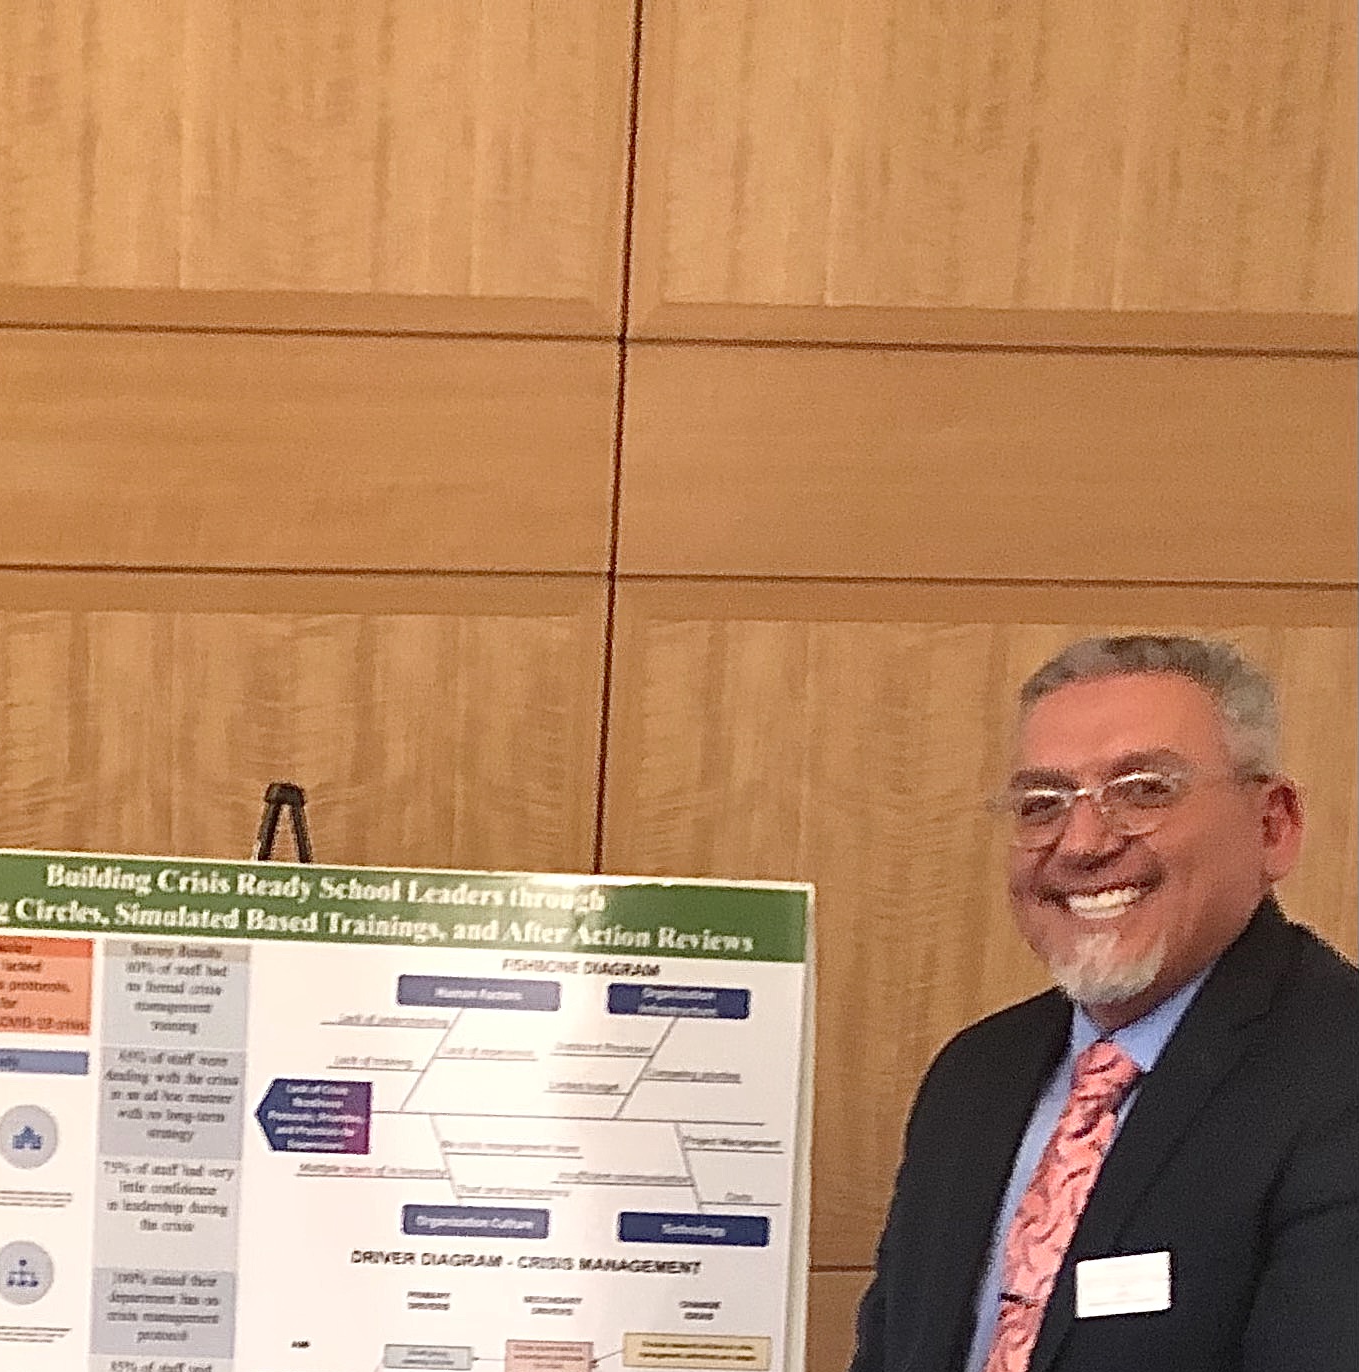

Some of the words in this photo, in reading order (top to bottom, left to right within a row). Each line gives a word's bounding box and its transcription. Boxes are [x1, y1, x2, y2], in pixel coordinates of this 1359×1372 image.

[47, 863, 152, 897] Building
[157, 869, 230, 895] Crisis
[237, 873, 311, 903] Ready
[319, 877, 401, 902] School
[408, 880, 504, 907] Leaders
[510, 886, 606, 913] through
[15, 898, 109, 926] Circles,
[115, 901, 240, 930] Simulated
[246, 908, 318, 933] Based
[326, 912, 447, 943] Trainings,
[453, 921, 499, 941] and
[503, 922, 569, 945] After
[575, 926, 651, 948] Action
[658, 928, 754, 952] Reviews
[583, 960, 660, 978] DIAGRAM
[350, 1248, 417, 1267] DRIVER
[421, 1251, 503, 1269] DIAGRAM
[517, 1254, 575, 1272] CRISIS
[578, 1256, 702, 1276] MANAGEMENT
